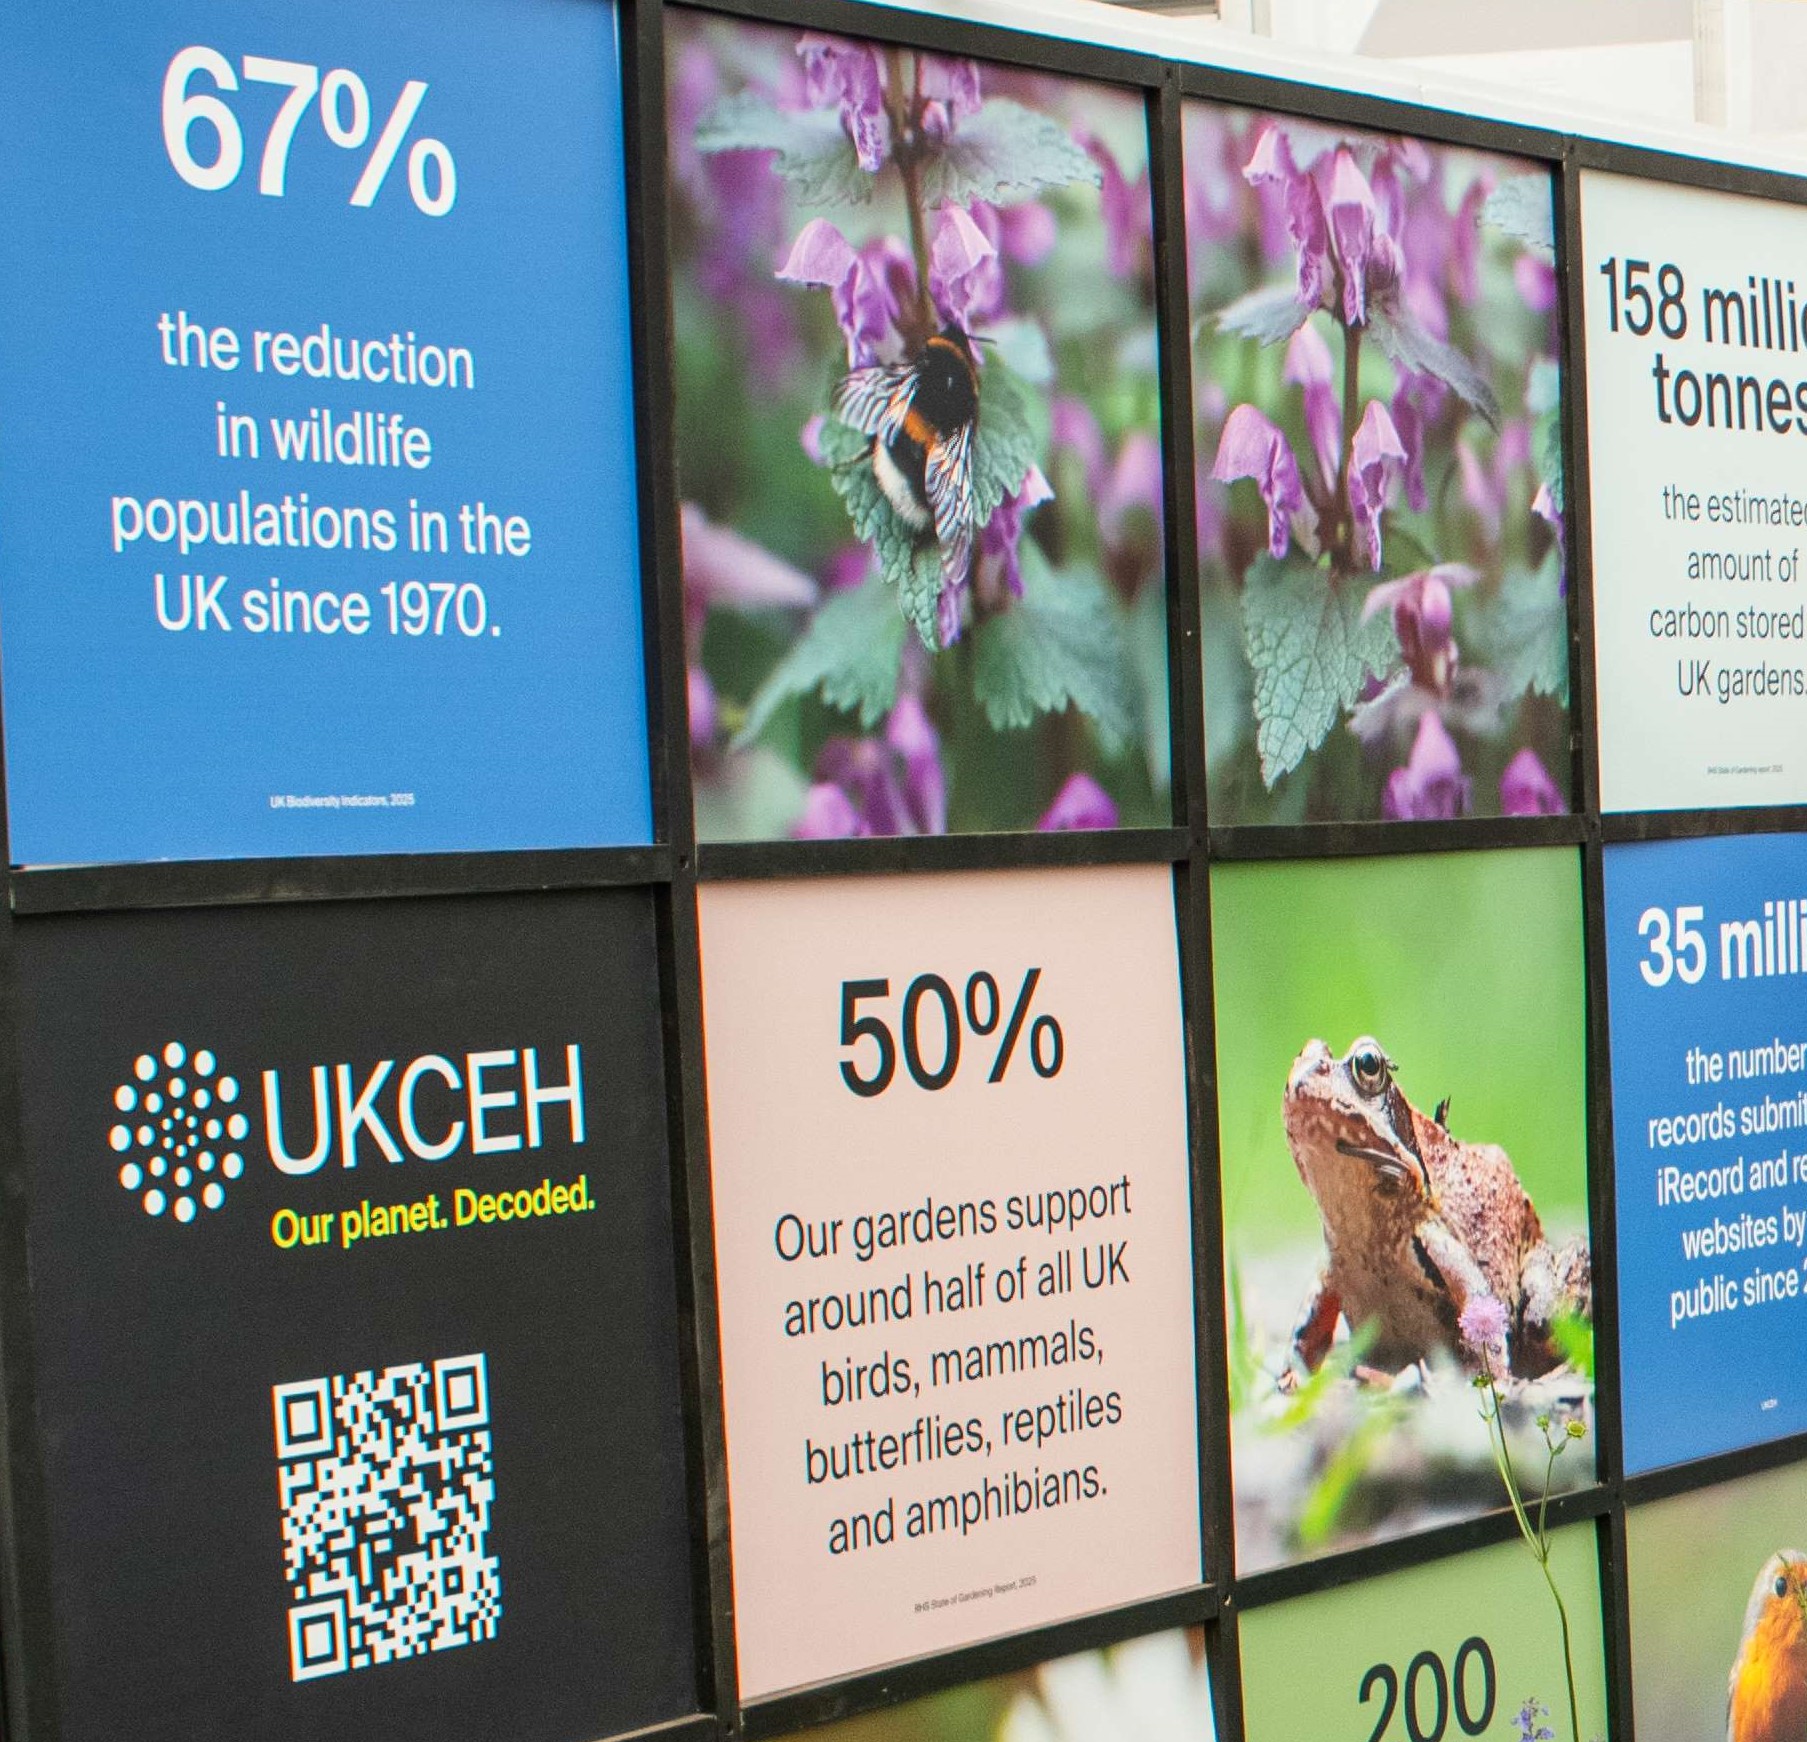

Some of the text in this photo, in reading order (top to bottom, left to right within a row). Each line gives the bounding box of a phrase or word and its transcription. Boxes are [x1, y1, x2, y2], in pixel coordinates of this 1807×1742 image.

[161, 45, 458, 217] 67%
[1600, 256, 1687, 341] 158
[159, 311, 475, 389] the reduction
[216, 402, 431, 469] in wildlife
[112, 491, 532, 557] populations in the
[1662, 484, 1701, 523] the
[1687, 548, 1800, 584] amount of
[154, 573, 502, 637] UK since 1970.
[1649, 605, 1730, 640] carbon
[1736, 608, 1804, 641] stored
[1676, 660, 1712, 696] UK
[1638, 905, 1707, 988] 35
[840, 966, 1065, 1099] 50%
[1686, 1047, 1723, 1086] the
[262, 1043, 587, 1176] UKCEH
[1648, 1103, 1736, 1150] records
[271, 1175, 596, 1251] Our planet. Decoded.
[1657, 1162, 1745, 1208] iRecord
[1749, 1150, 1788, 1190] and
[775, 1174, 1133, 1263] Our gardens support
[1682, 1213, 1779, 1263] websites
[1783, 1208, 1807, 1248] by
[784, 1241, 1131, 1338] around half of all UK
[1670, 1276, 1737, 1330] public
[1743, 1262, 1800, 1305] since
[821, 1318, 1105, 1406] birds, mammals,
[805, 1384, 1123, 1486] butterflies, reptiles
[828, 1459, 1109, 1555] and amphibians.
